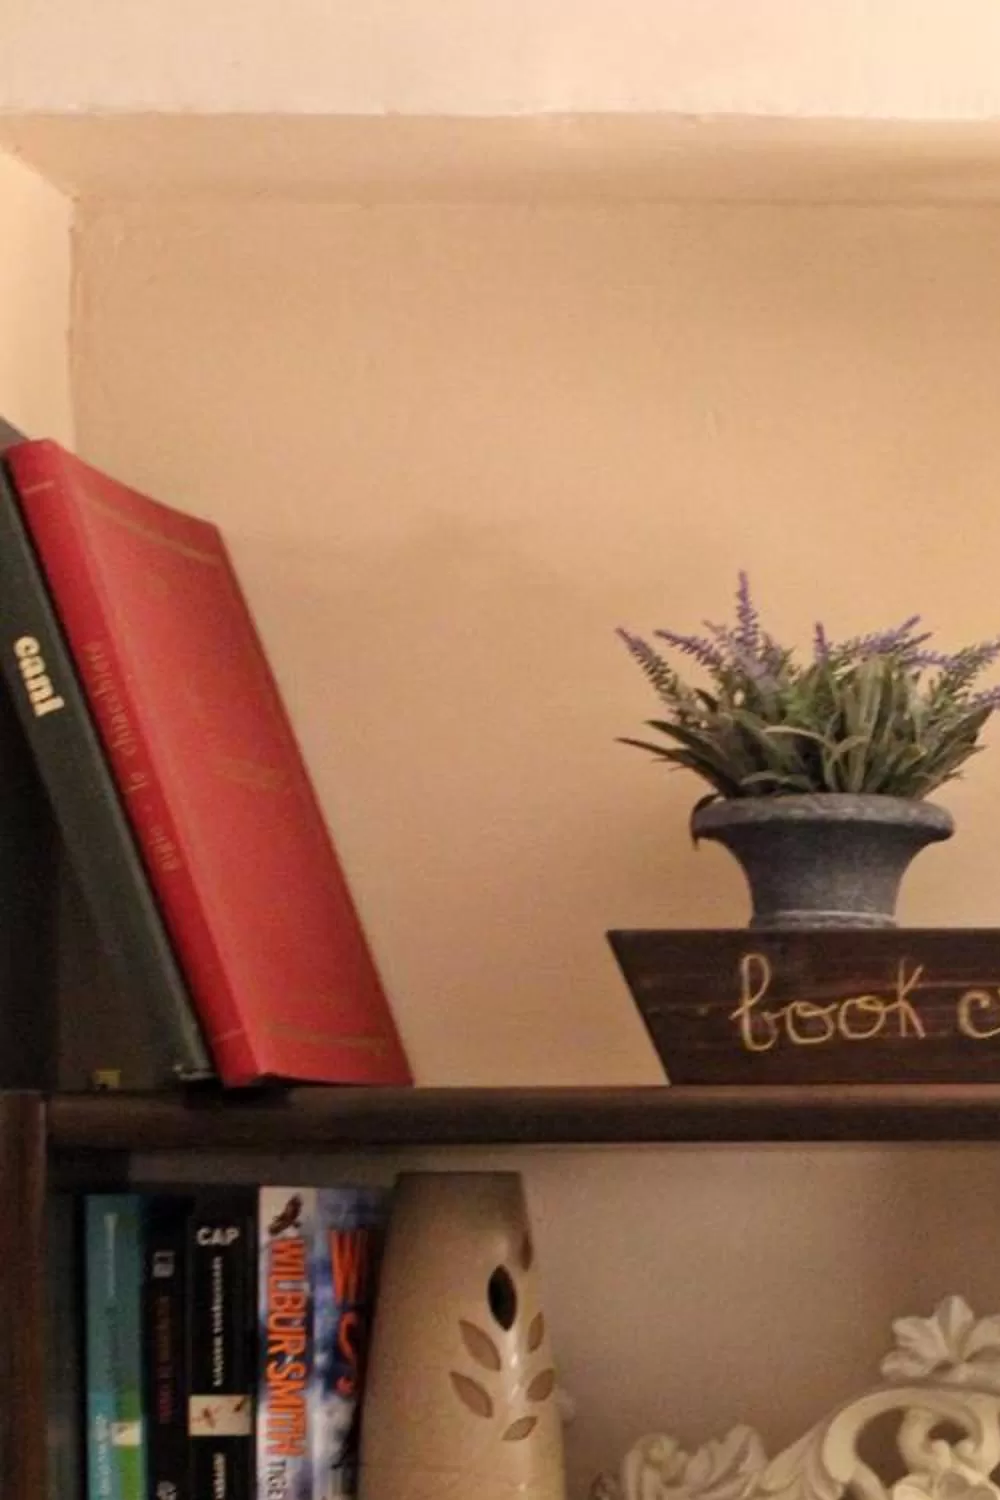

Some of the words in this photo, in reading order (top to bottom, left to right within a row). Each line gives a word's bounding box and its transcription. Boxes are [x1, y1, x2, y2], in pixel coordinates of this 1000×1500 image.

[731, 952, 927, 1053] book
[266, 1239, 307, 1357] WILBUR
[266, 1360, 307, 1456] SMITH
